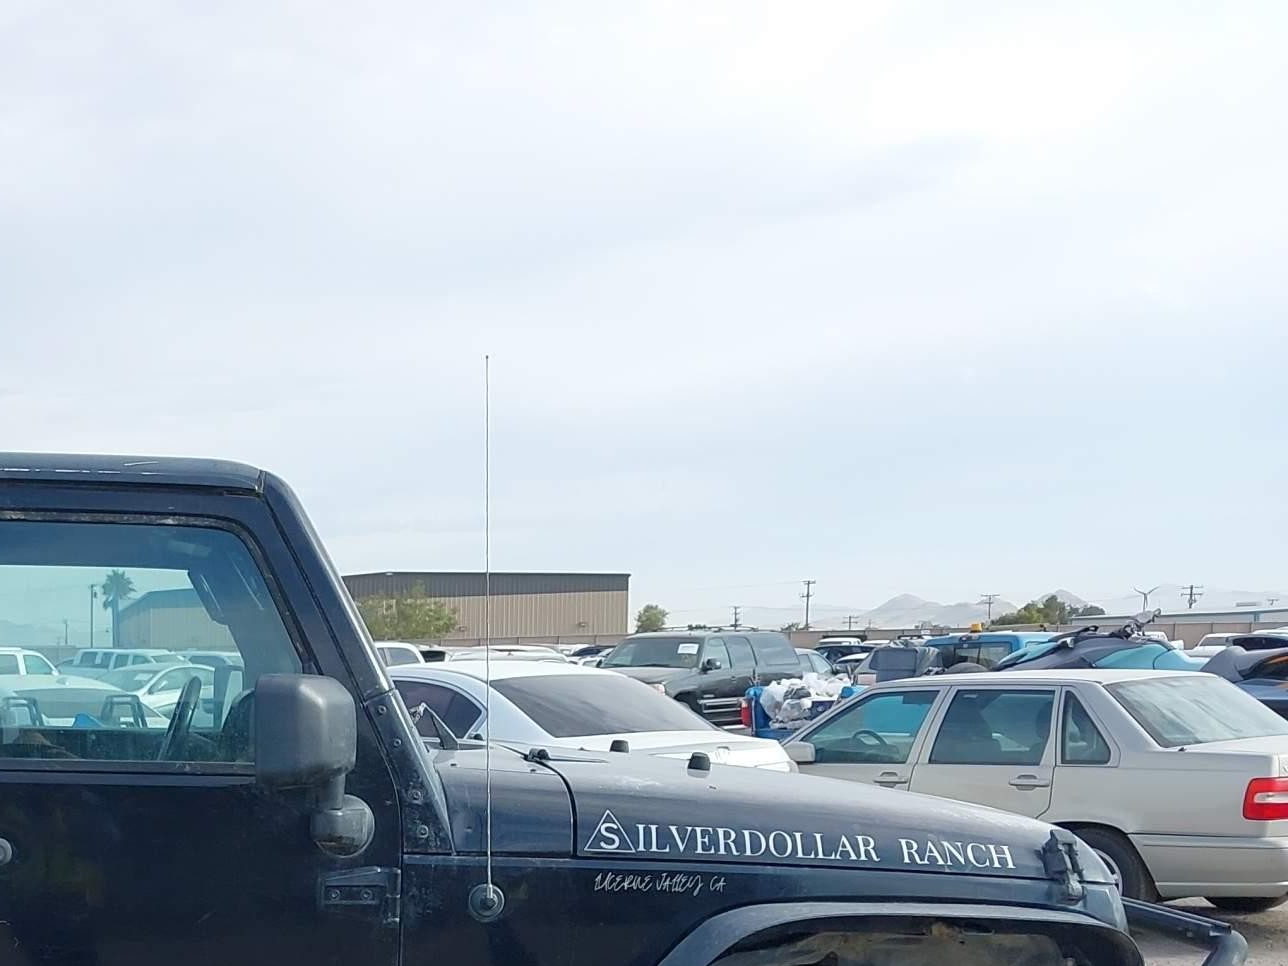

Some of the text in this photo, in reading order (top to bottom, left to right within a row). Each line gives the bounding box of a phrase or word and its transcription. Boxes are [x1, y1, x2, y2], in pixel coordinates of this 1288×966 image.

[599, 821, 1017, 869] SILVERDOLLAR RANCH
[709, 875, 727, 892] CA
